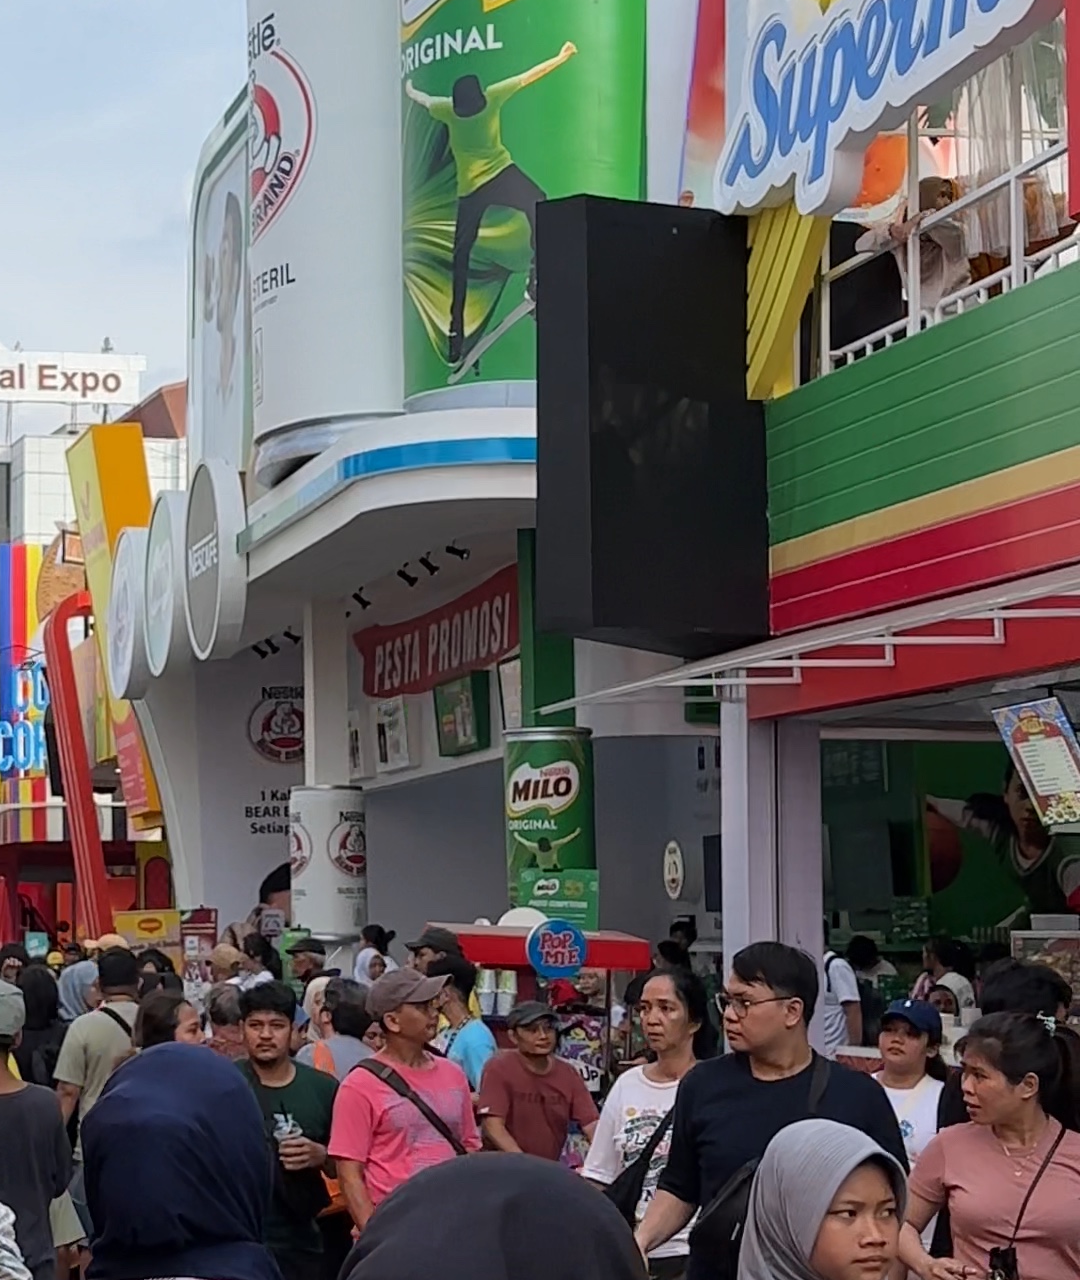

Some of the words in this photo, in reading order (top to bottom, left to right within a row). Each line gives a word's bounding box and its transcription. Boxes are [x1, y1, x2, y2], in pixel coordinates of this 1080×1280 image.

[37, 364, 122, 398] Expo
[373, 630, 420, 694] PESTA
[427, 592, 511, 677] PROMOSI
[260, 790, 266, 802] 1
[270, 789, 292, 802] Kal
[511, 776, 573, 804] MILO
[244, 806, 281, 818] BEAR
[508, 819, 558, 831] ORIGINAL
[538, 930, 573, 951] POP
[541, 948, 580, 967] MIE
